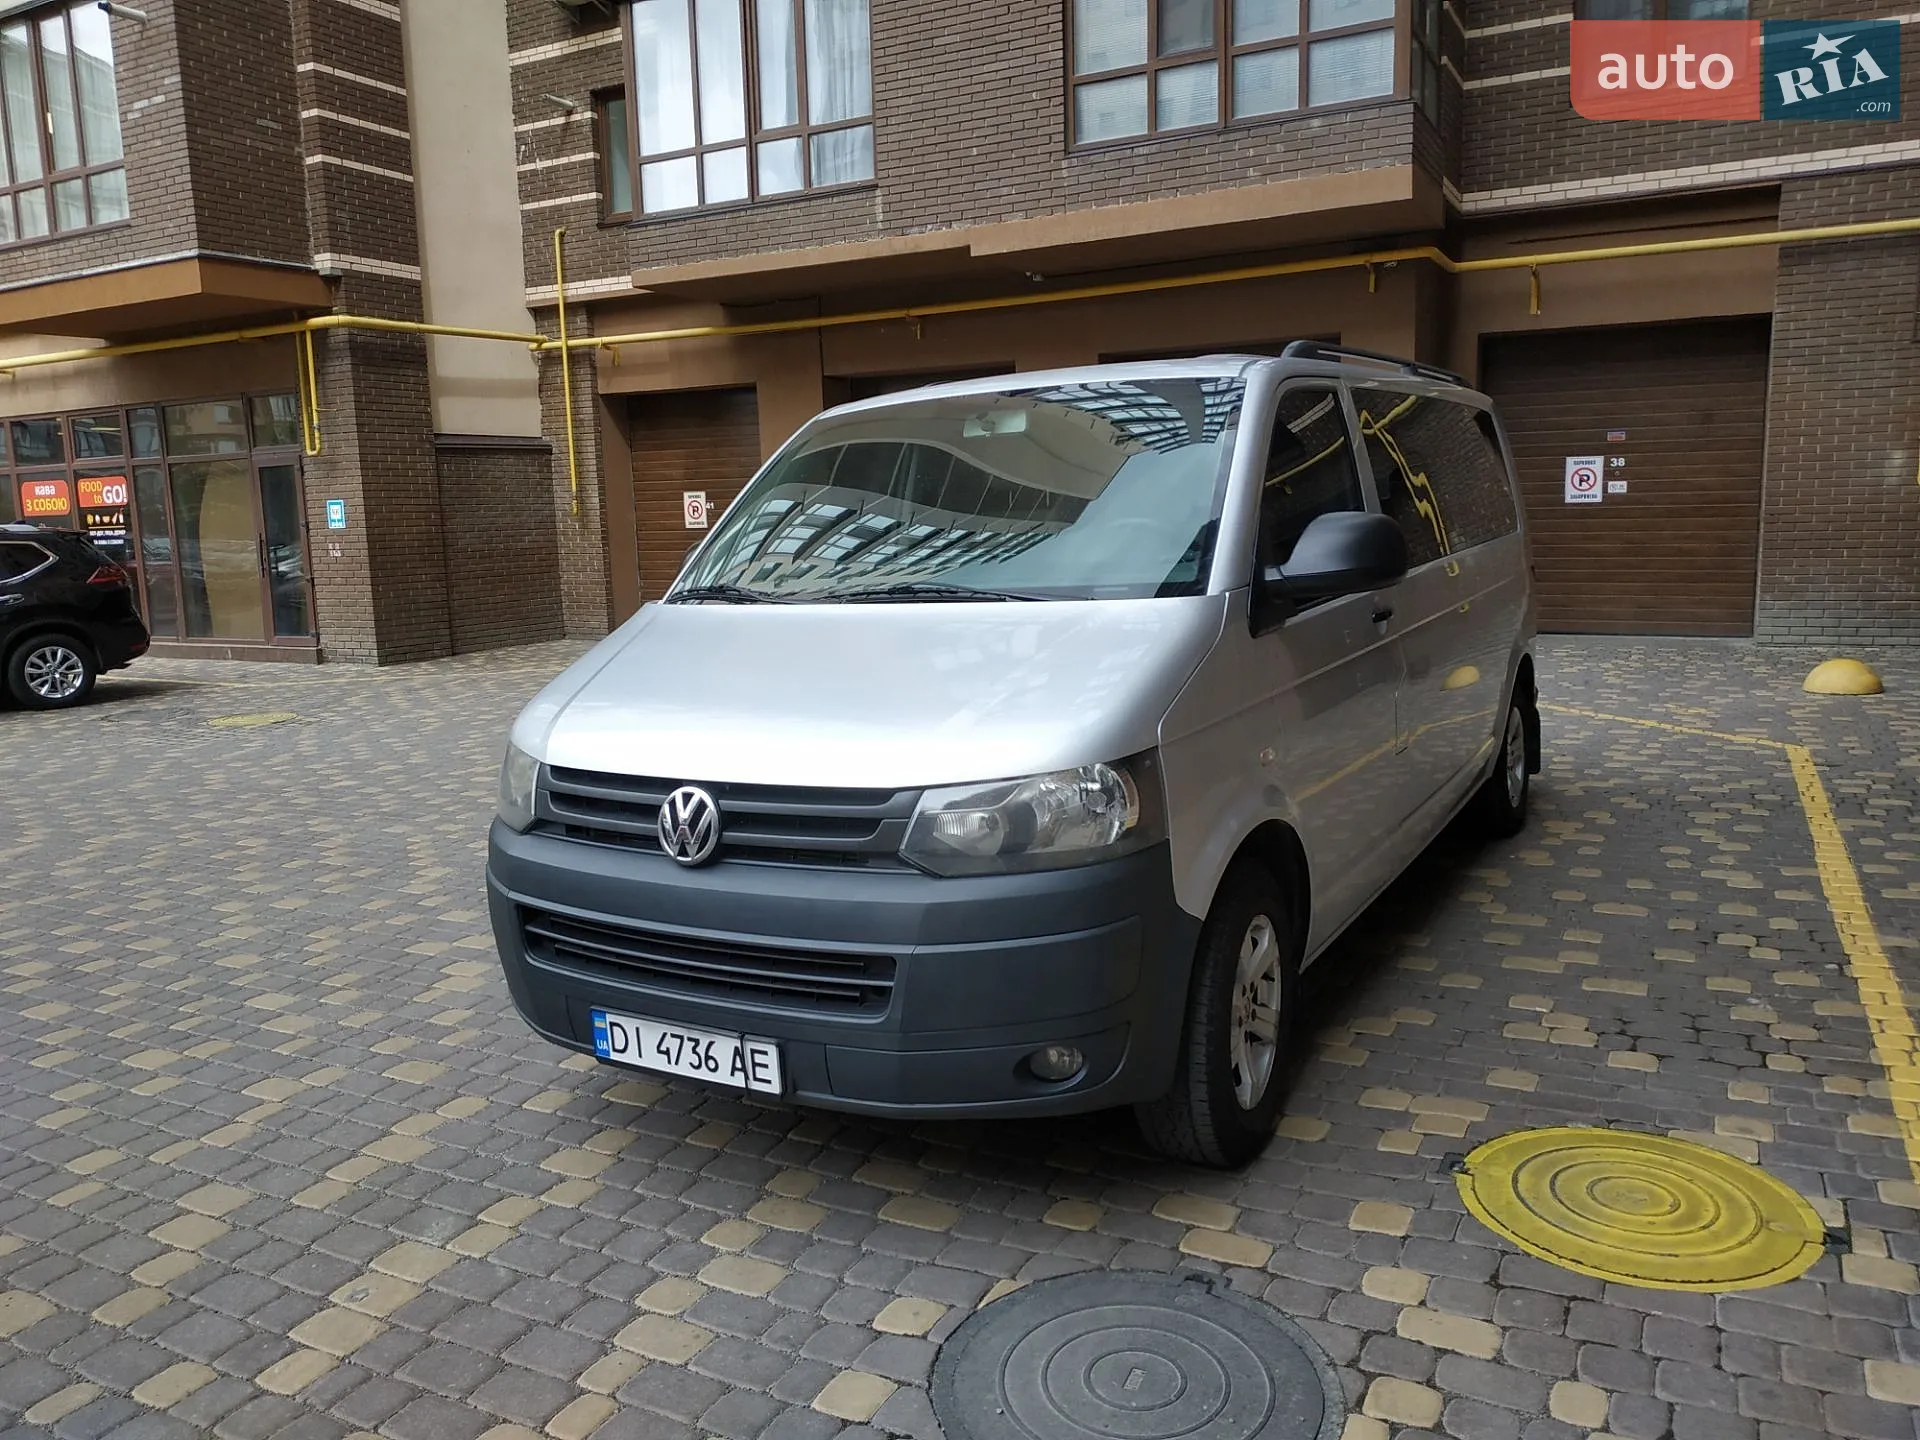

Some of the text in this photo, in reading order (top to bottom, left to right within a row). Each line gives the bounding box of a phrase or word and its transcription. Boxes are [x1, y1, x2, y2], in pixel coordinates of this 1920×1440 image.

[1610, 457, 1625, 467] 38
[80, 481, 103, 493] FOOD
[93, 484, 128, 504] to GO!
[33, 498, 68, 512] СОБОЮ
[596, 1039, 608, 1051] UA
[609, 1021, 772, 1084] DI 4736 AE
